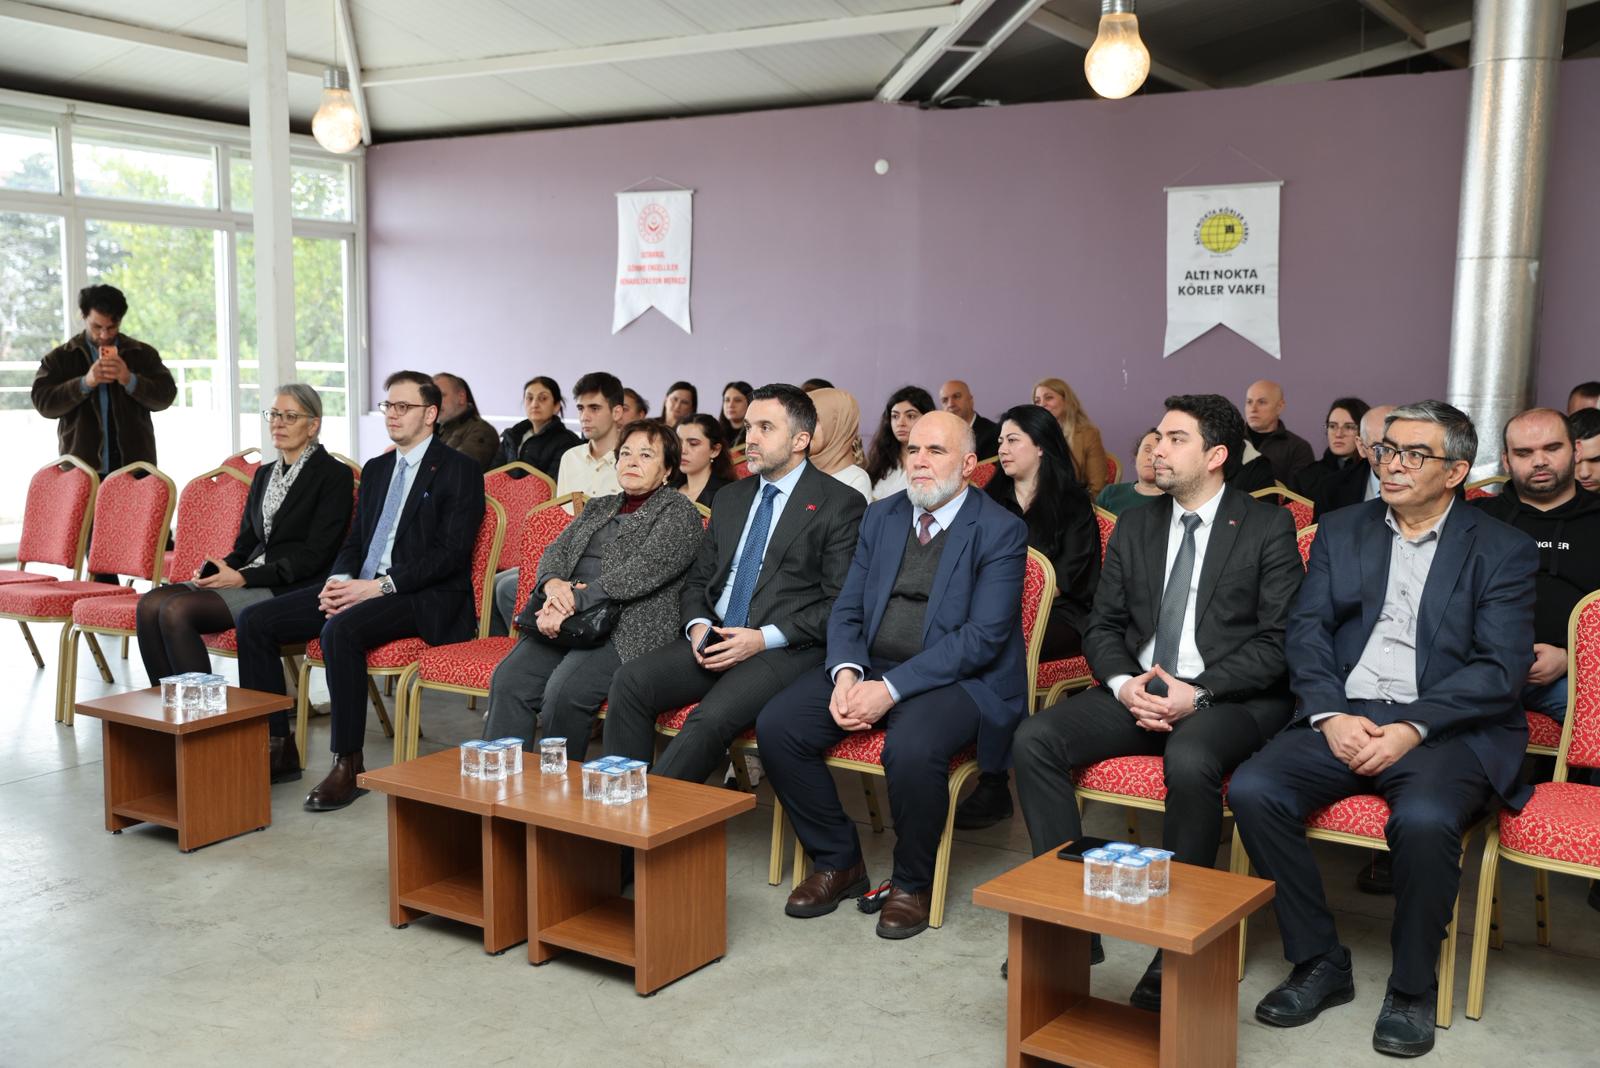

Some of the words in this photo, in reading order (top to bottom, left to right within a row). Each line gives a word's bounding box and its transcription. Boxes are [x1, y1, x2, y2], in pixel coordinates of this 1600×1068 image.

[1185, 270, 1210, 280] ALTI
[1213, 268, 1258, 279] NOKTA
[1178, 283, 1224, 296] KÖRLER
[1227, 284, 1265, 295] VAKFI
